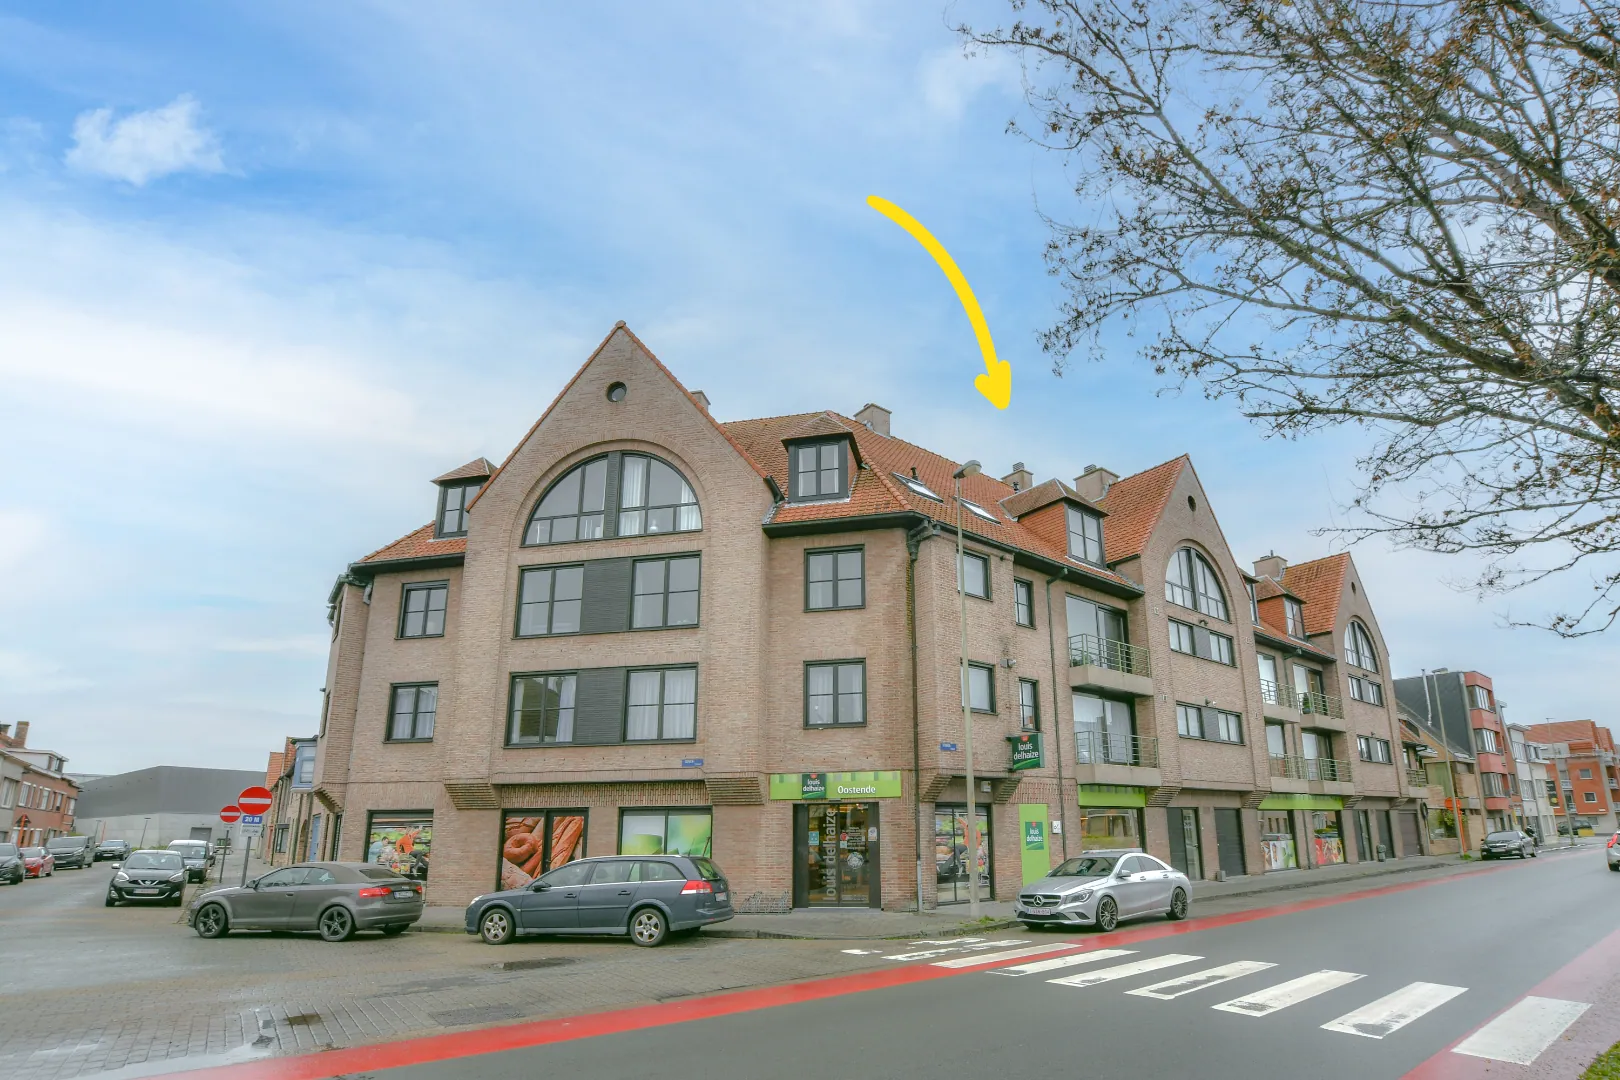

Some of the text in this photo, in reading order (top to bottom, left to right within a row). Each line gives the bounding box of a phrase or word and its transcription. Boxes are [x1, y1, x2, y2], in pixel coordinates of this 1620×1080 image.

[1018, 742, 1033, 751] louis
[1013, 751, 1039, 760] delhaize
[837, 785, 876, 794] Oostende
[823, 809, 836, 901] louis delhaize
